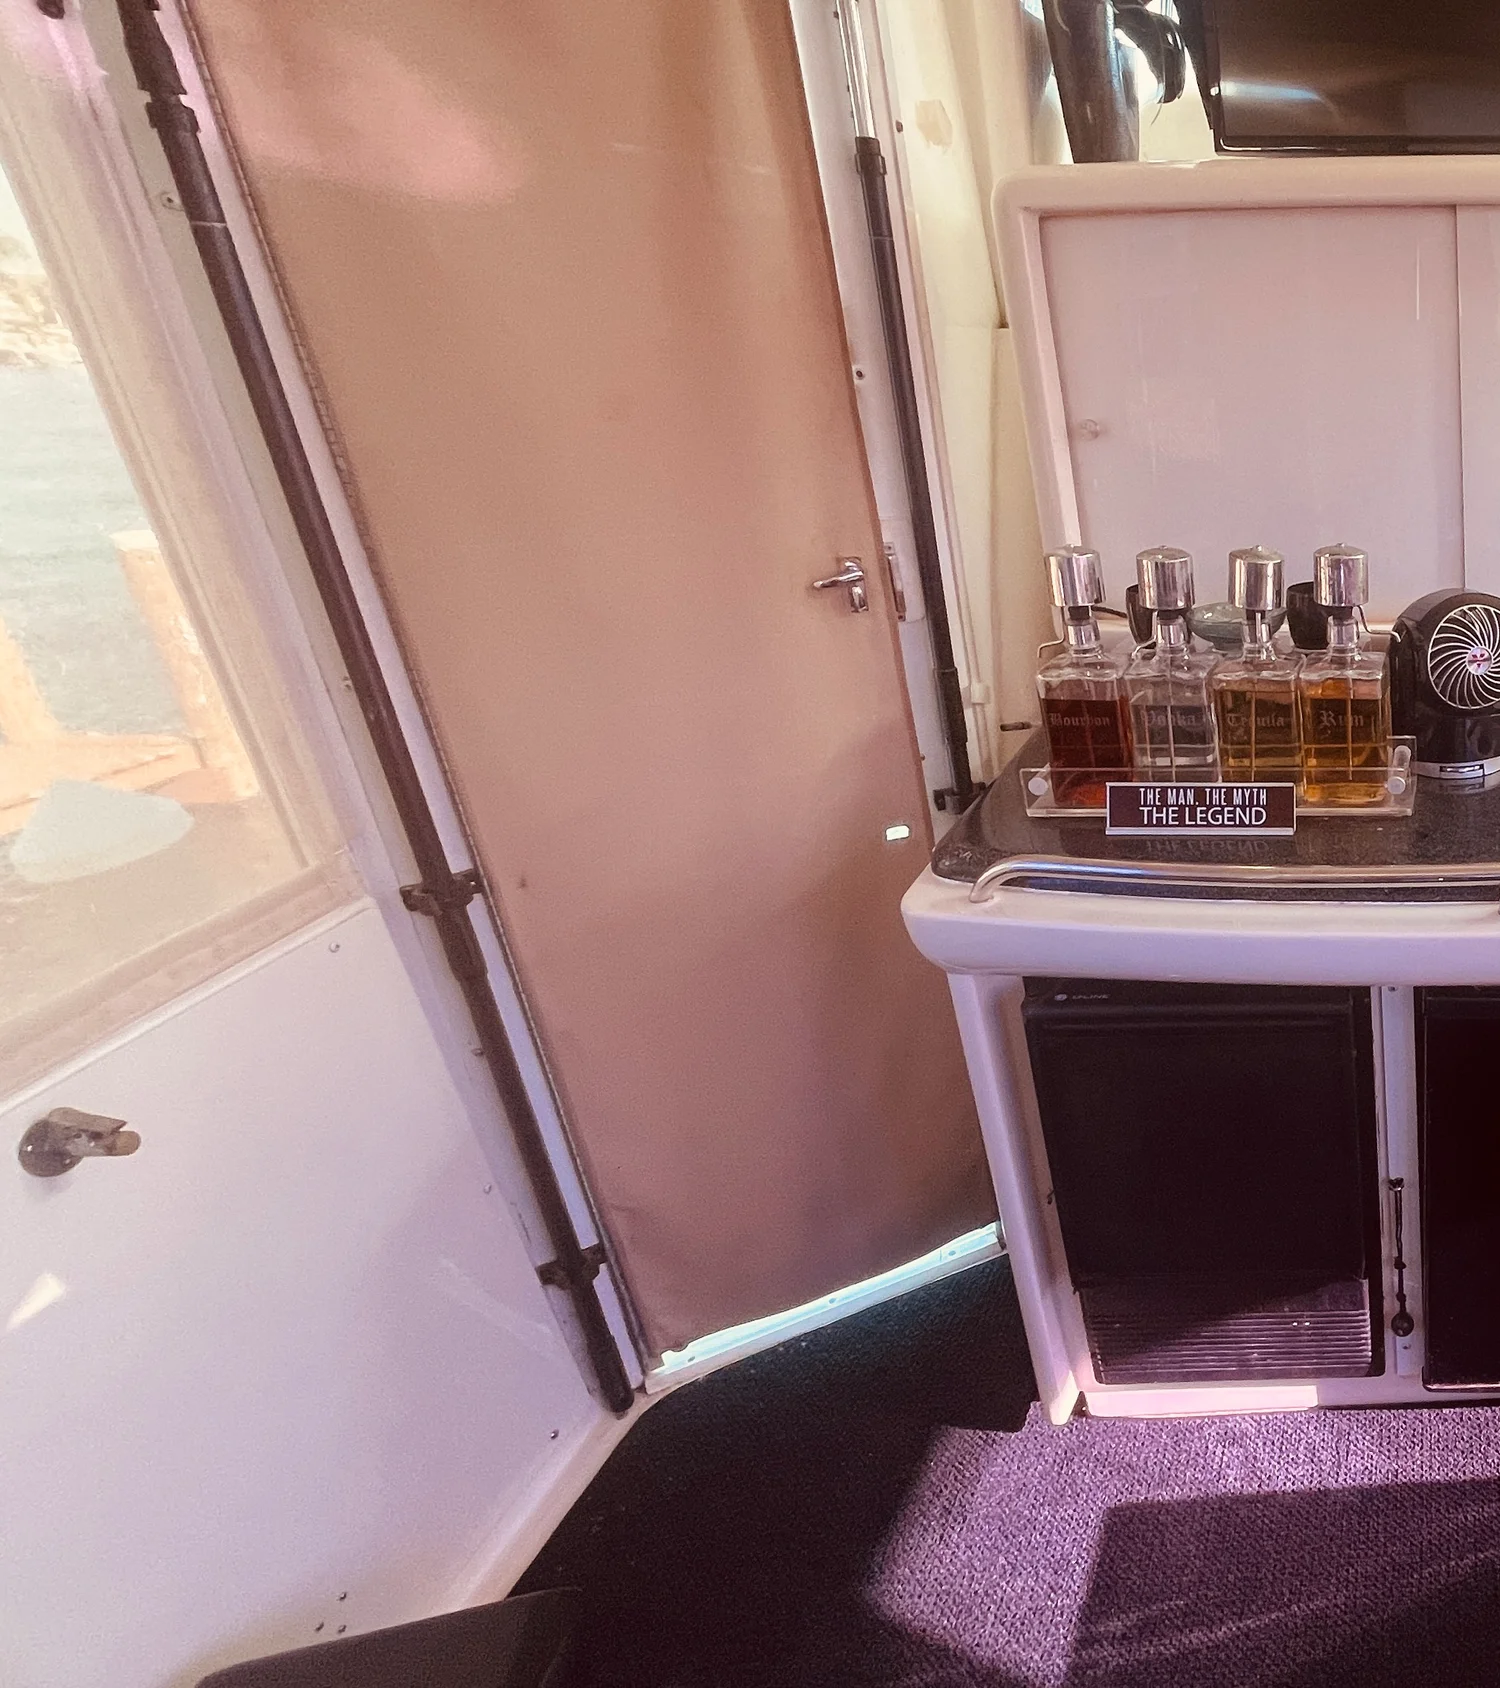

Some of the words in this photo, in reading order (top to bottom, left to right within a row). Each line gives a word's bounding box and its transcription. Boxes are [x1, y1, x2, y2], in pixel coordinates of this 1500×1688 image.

[1049, 712, 1110, 727] Bourbon
[1226, 712, 1285, 727] Teuila
[1139, 788, 1161, 806] THE
[1205, 788, 1227, 806] THE
[1233, 788, 1267, 806] MYTH
[1139, 806, 1179, 825] THE
[1185, 806, 1267, 825] LEGEND
